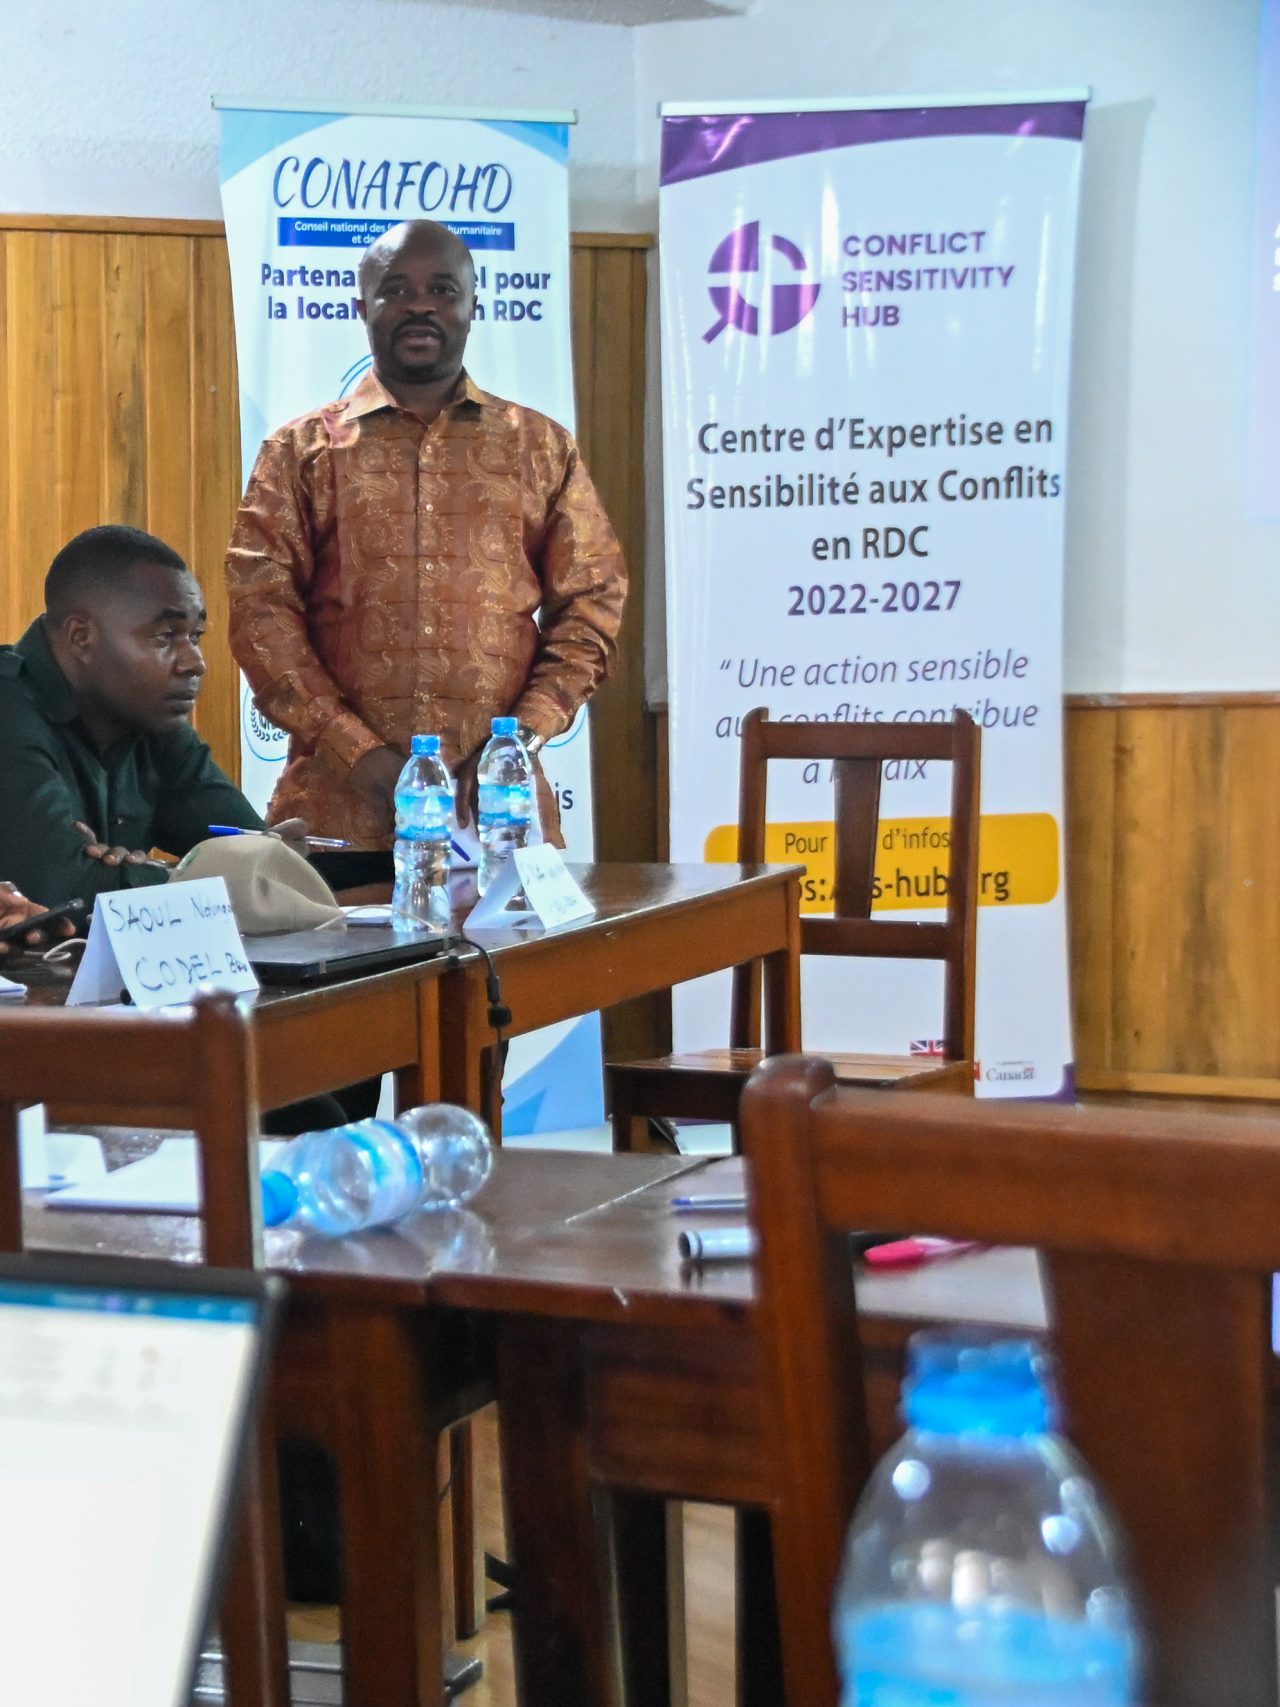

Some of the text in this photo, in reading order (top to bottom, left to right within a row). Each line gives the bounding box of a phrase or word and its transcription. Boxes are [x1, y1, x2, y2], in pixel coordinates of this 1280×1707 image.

[273, 156, 512, 213] CONAFOHD
[294, 221, 329, 232] Conseil
[330, 222, 369, 233] national
[369, 223, 386, 233] des
[351, 236, 362, 244] et
[842, 231, 987, 257] CONFLICT
[261, 263, 357, 287] Partena
[495, 272, 551, 295] pour
[842, 266, 1016, 293] SENSITIVITY
[267, 296, 288, 320] la
[494, 299, 543, 321] RDC
[842, 305, 900, 328] HUB
[697, 421, 806, 455] Centre
[1013, 418, 1053, 445] en
[686, 465, 1062, 511] Sensibilité aux Conflits
[811, 526, 930, 561] en RDC
[787, 580, 962, 616] 2022-2027
[738, 658, 795, 688] Une
[804, 655, 897, 685] action
[906, 648, 1030, 682] sensible
[884, 759, 928, 781] aix
[784, 832, 828, 854] Pour
